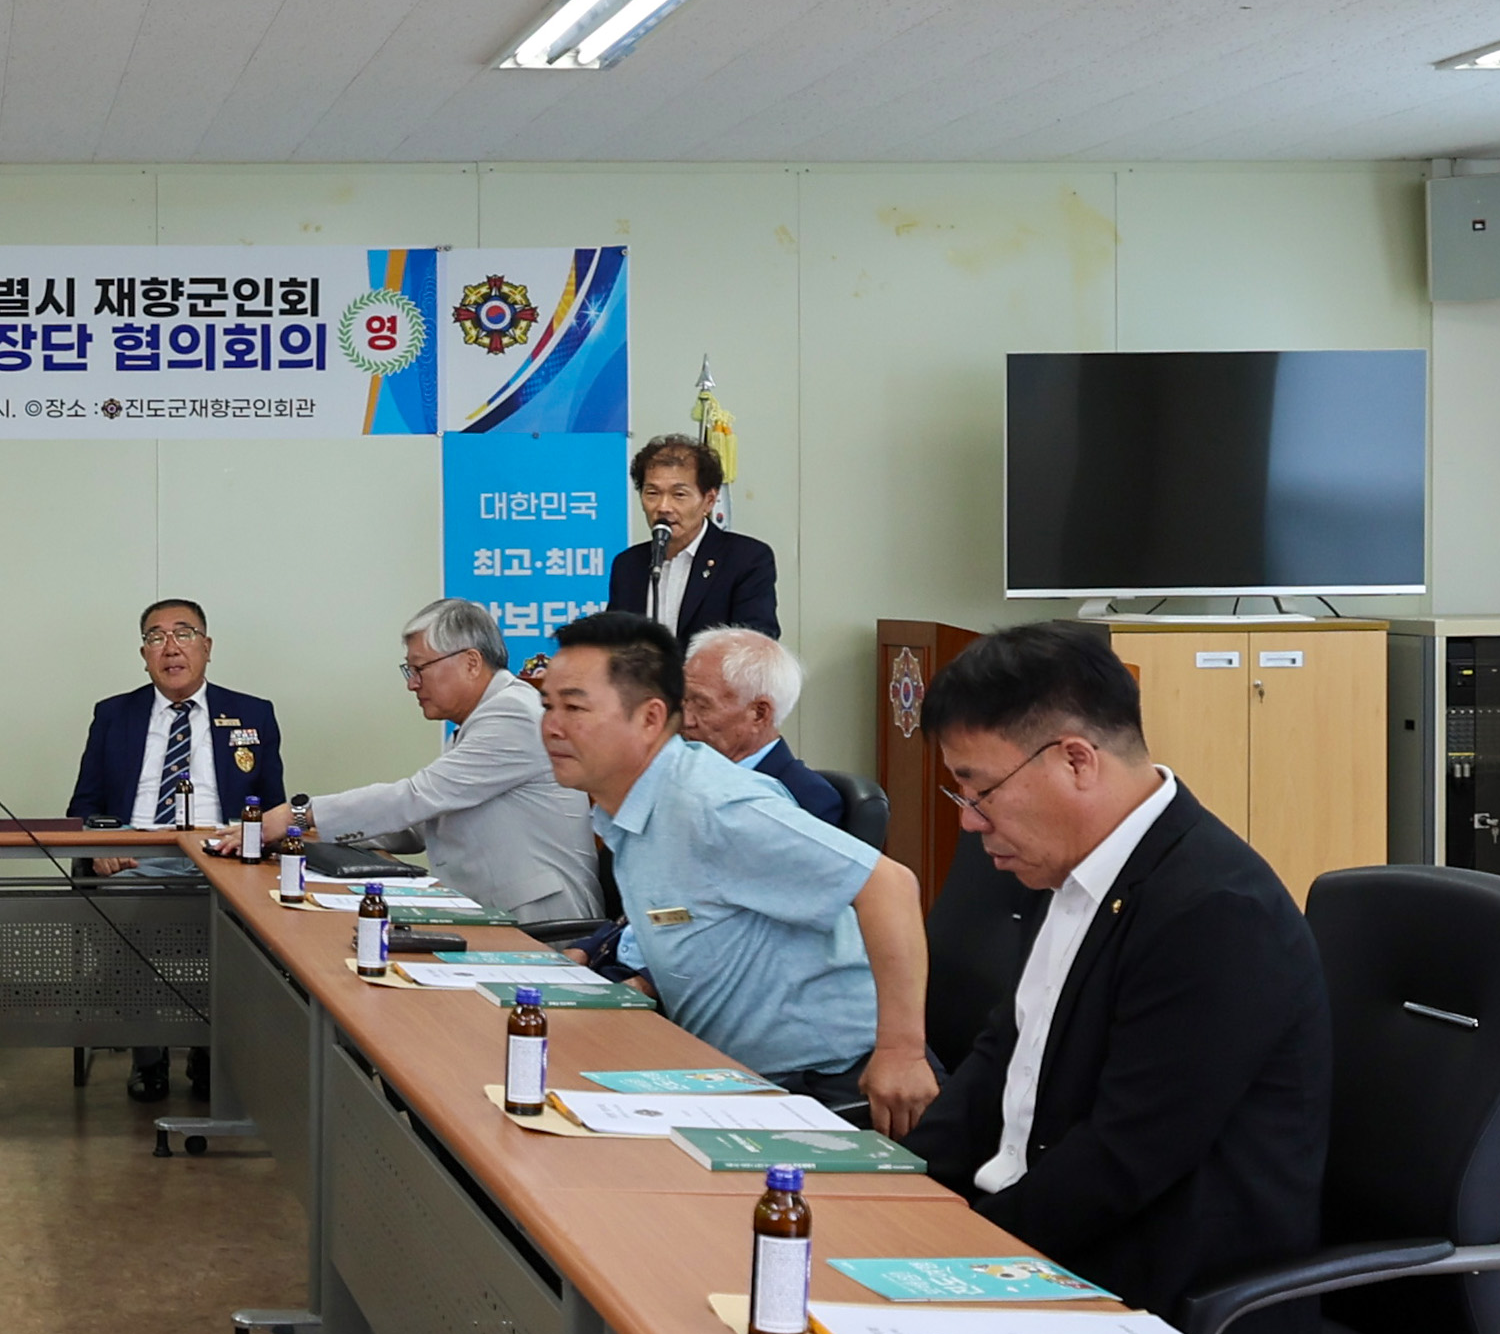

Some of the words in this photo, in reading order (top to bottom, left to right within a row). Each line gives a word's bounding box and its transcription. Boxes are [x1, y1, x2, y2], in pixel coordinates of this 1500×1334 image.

[93, 277, 320, 318] 재향군인회
[111, 323, 327, 372] 협의회의
[365, 315, 398, 352] 영
[124, 398, 317, 418] 진도군재향군인회관
[480, 492, 598, 520] 대한민국
[473, 548, 605, 577] 최고·최대
